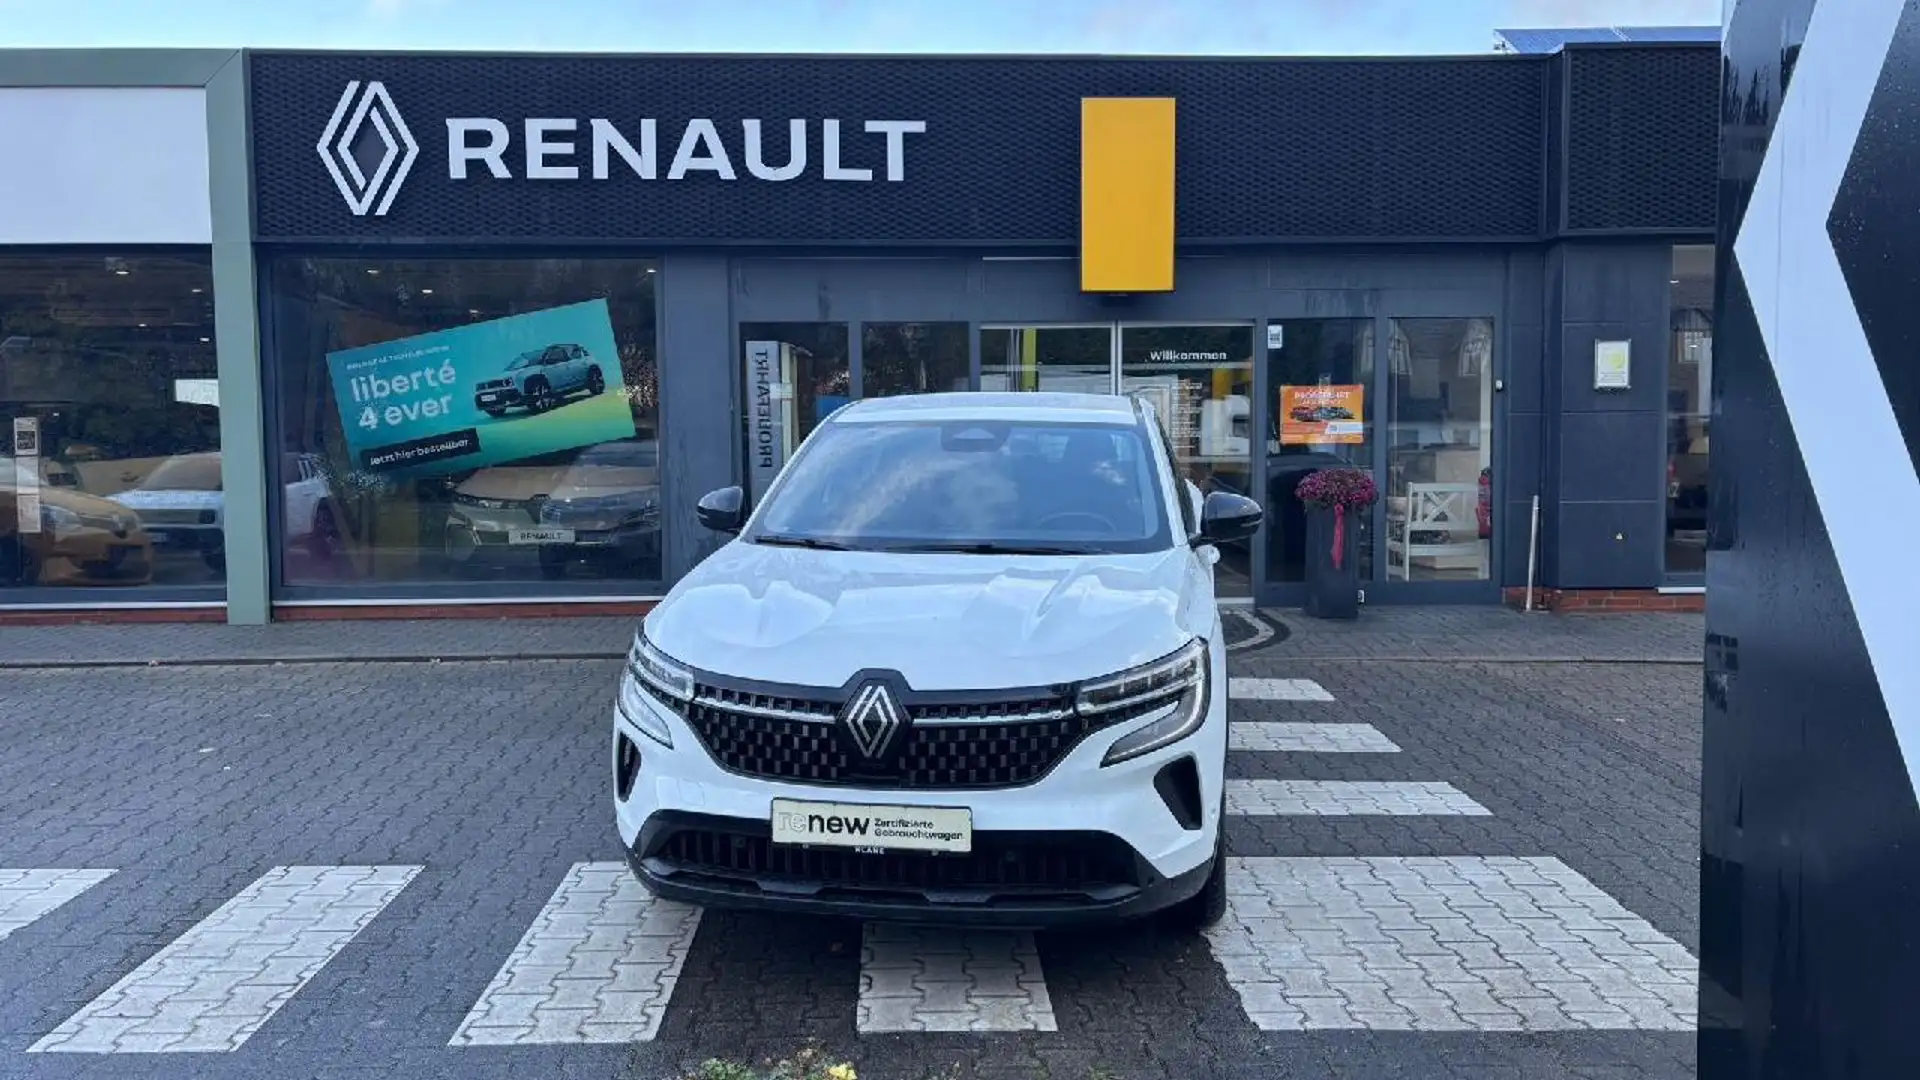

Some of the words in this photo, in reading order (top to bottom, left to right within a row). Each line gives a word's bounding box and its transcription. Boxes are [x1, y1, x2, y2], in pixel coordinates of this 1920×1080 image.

[446, 117, 927, 182] RENAULT
[1150, 350, 1228, 362] Willkommen
[351, 358, 456, 402] liberté
[359, 406, 379, 429] 4
[384, 394, 453, 426] ever
[370, 453, 395, 466] Jetzt
[395, 449, 415, 460] hier
[778, 812, 870, 836] renew
[874, 817, 934, 829] Zertifizierte
[874, 828, 963, 842] Gebrauchtwagen
